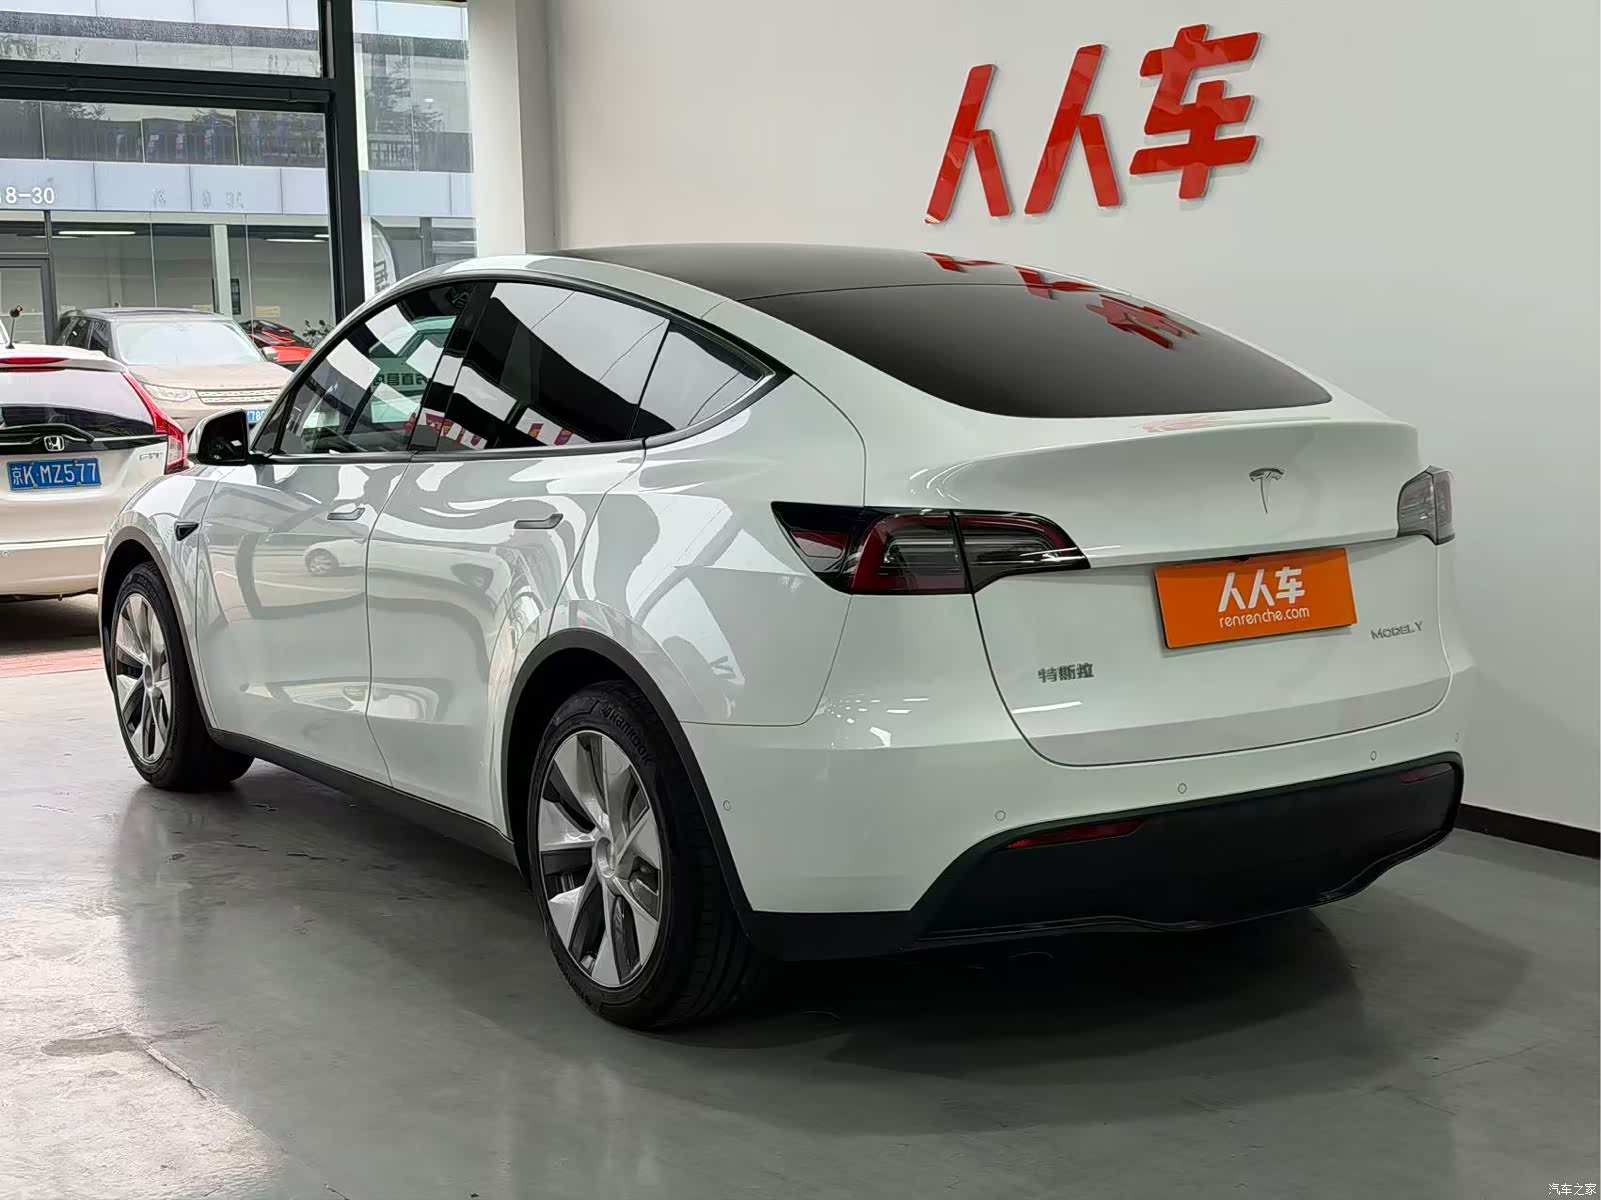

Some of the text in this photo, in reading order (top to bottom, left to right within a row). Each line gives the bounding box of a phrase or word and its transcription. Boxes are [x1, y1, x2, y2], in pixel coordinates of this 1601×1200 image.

[924, 23, 1261, 224] 人人车
[0, 186, 55, 204] 8-30
[1218, 566, 1305, 613] 人人车
[1219, 607, 1310, 628] renrenche.com
[1037, 662, 1095, 683] 特斯拉
